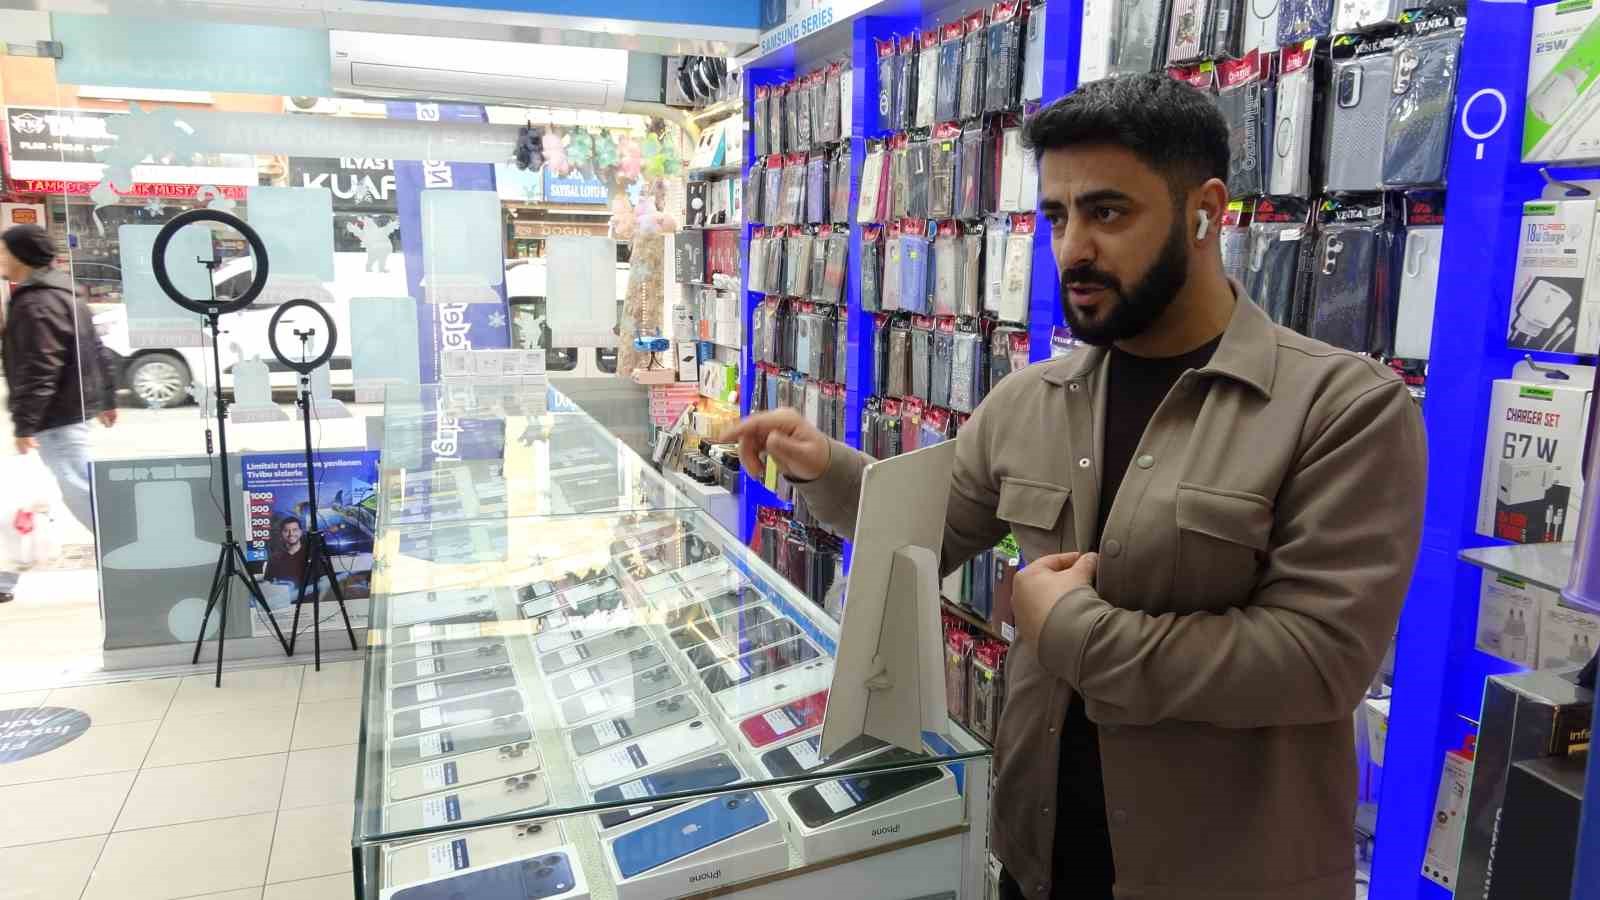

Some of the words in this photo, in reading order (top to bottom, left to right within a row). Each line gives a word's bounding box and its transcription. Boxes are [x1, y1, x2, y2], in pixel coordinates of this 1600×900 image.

[760, 23, 800, 54] SAMSUNG
[1535, 38, 1568, 54] 25W
[1506, 407, 1543, 426] CHARGER
[1544, 412, 1561, 428] SET
[1502, 432, 1532, 459] 67
[1537, 437, 1558, 463] W
[252, 505, 270, 513] 500
[252, 518, 270, 526] 200
[253, 529, 270, 538] 100
[872, 823, 901, 837] iPhone
[689, 869, 722, 883] iPhone
